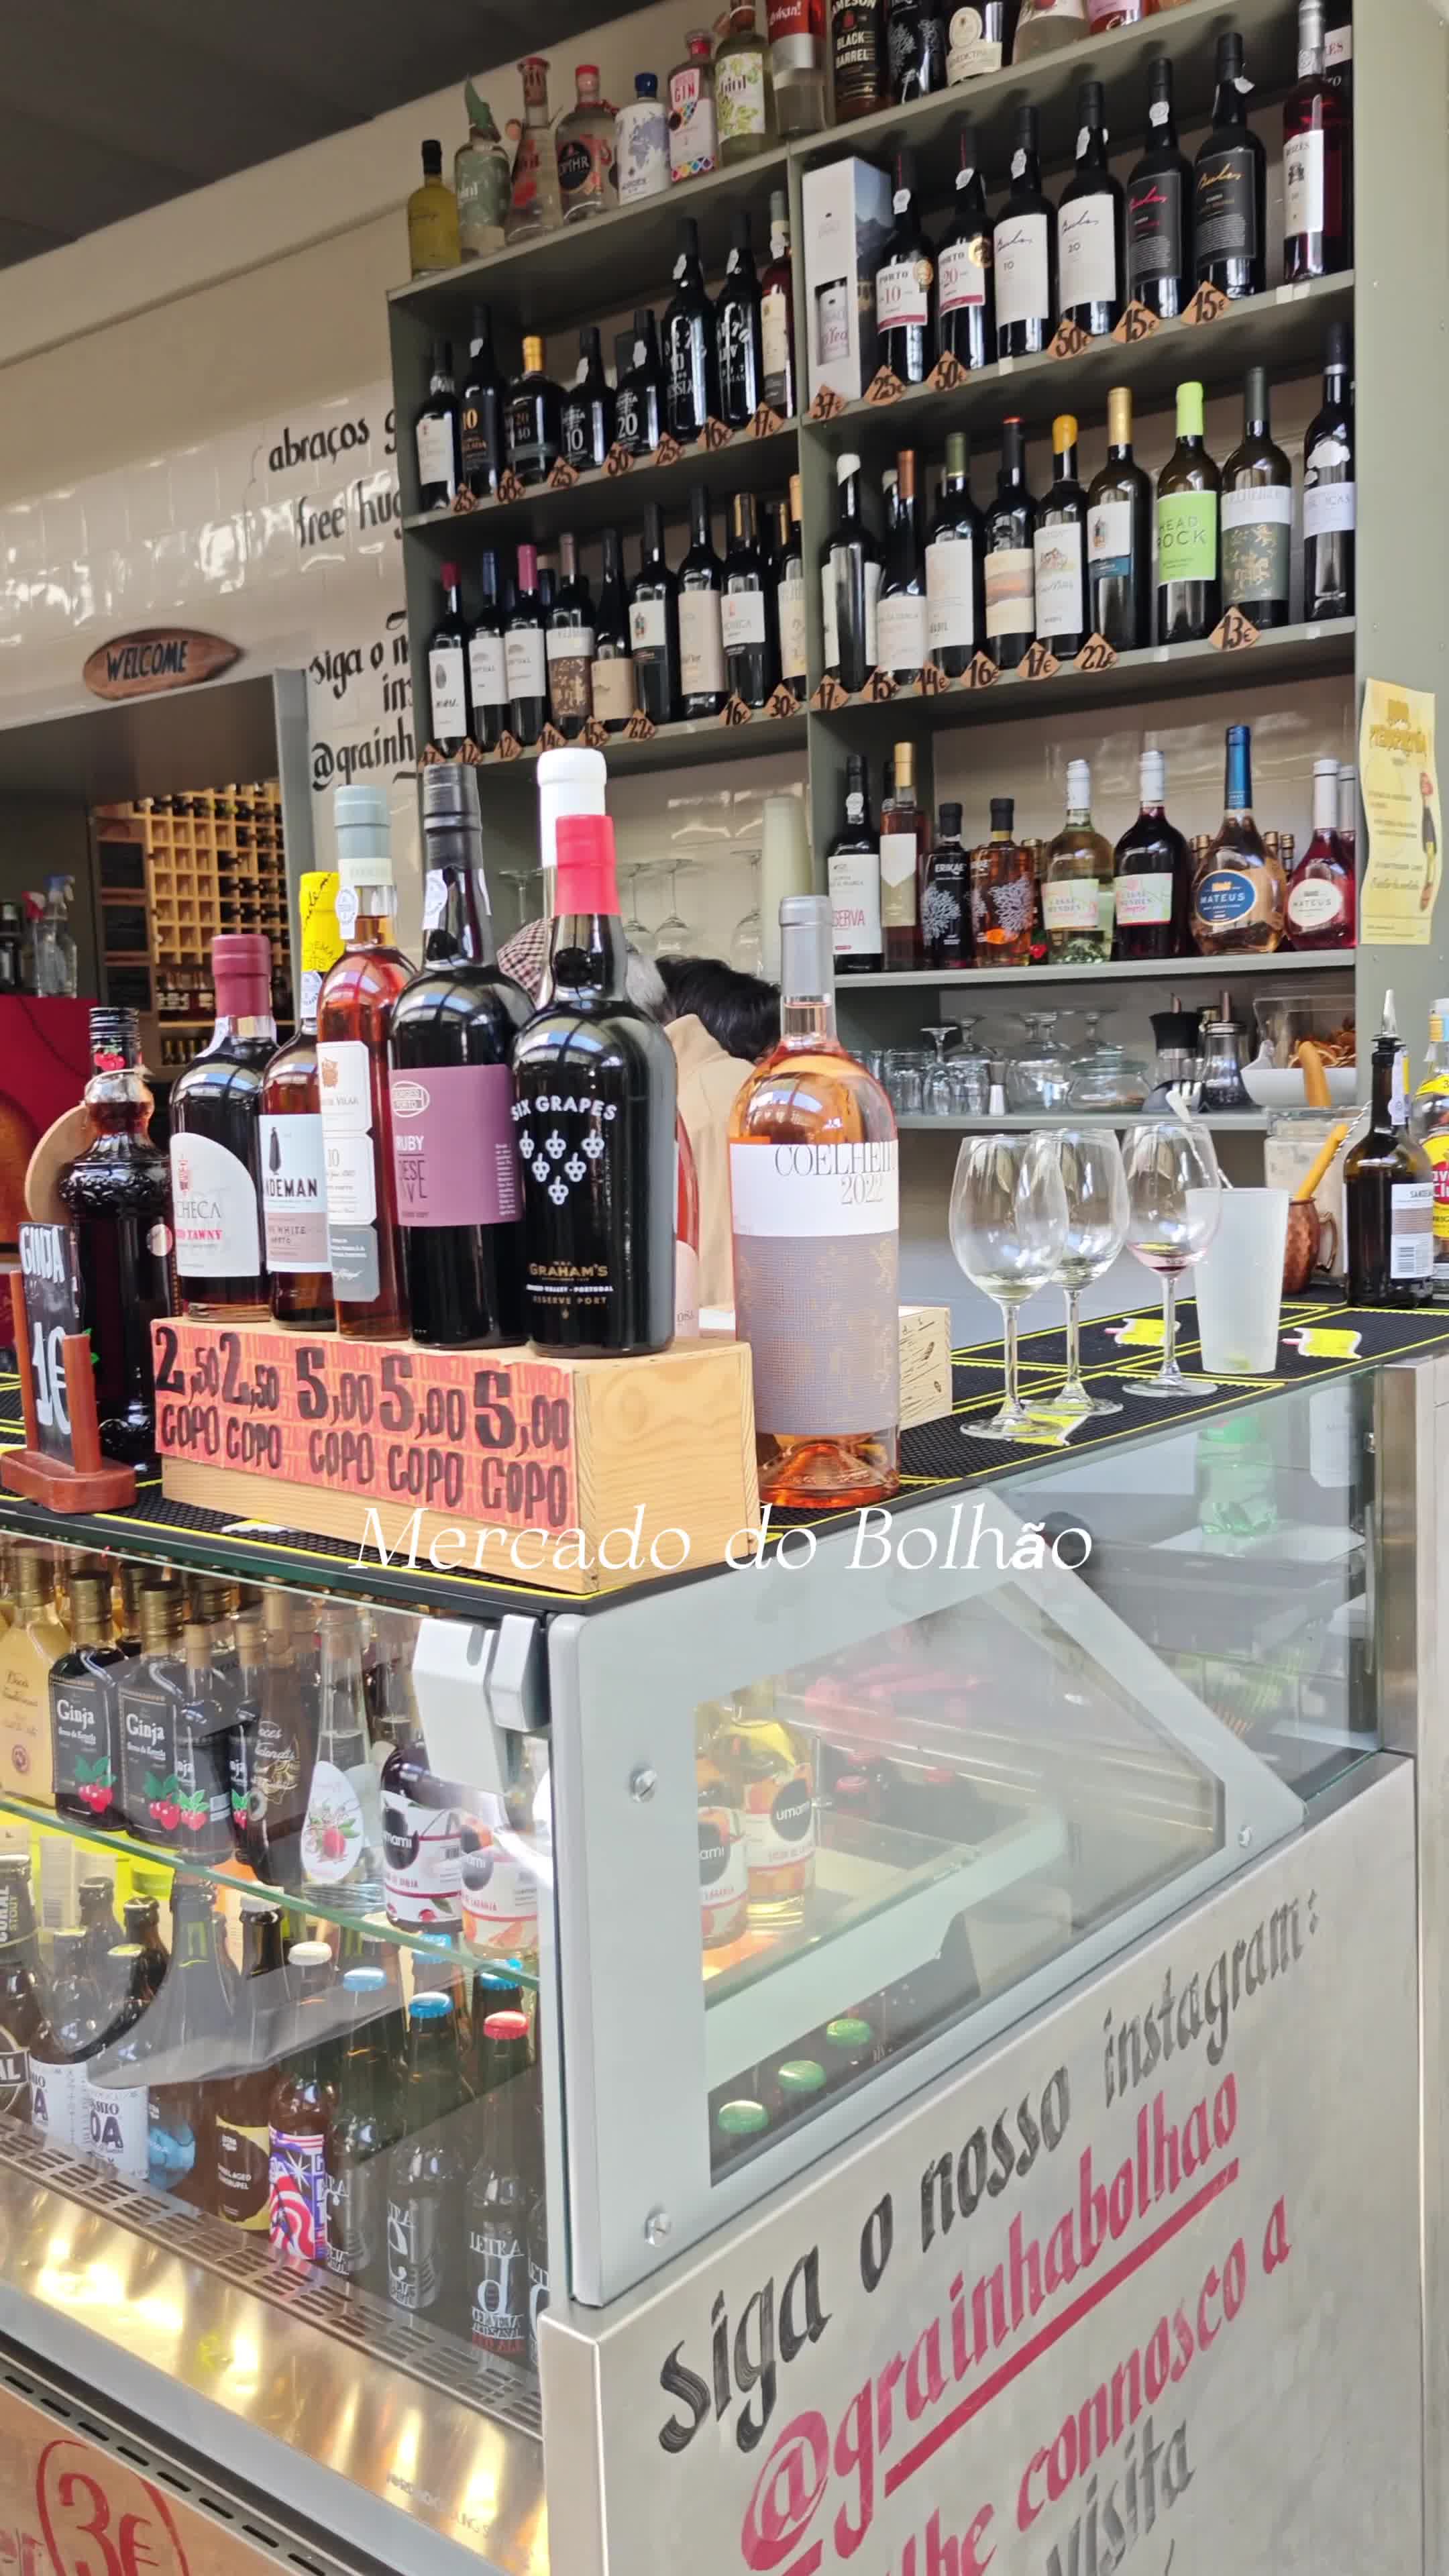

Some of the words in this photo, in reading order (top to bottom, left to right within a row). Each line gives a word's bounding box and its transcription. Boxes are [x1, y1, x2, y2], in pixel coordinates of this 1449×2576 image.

[837, 31, 865, 50] BLACK
[836, 48, 869, 69] BARREL
[675, 83, 695, 103] GIN
[885, 286, 902, 304] 10
[1190, 288, 1225, 324] 15€
[1121, 308, 1157, 343] 15€
[566, 428, 584, 452] 10
[617, 413, 638, 439] 20
[269, 417, 370, 473] abraços
[295, 496, 345, 548] free
[1219, 614, 1252, 649] 13€
[107, 640, 189, 682] WELCOME
[309, 648, 364, 700] siga
[370, 641, 384, 669] o
[969, 659, 999, 687] 16€
[1026, 648, 1053, 678] 17€
[1081, 644, 1114, 670] 22€
[817, 683, 841, 710] 17€
[916, 667, 946, 696] 14€
[724, 700, 748, 725] 16€
[770, 694, 796, 718] 30€
[629, 717, 652, 739] 22€
[1199, 892, 1246, 904] MATEUS
[511, 1099, 532, 1122] SIX
[535, 1095, 617, 1121] GRAPES
[187, 1229, 223, 1240] TAWNY
[530, 1263, 609, 1277] GRAHAM'S
[577, 1295, 607, 1305] PORT
[154, 1326, 221, 1405] 2,50
[220, 1331, 280, 1413] 2,50
[296, 1346, 373, 1426] 5,00
[378, 1353, 466, 1442] 5,00
[161, 1401, 221, 1456] COPO
[474, 1368, 571, 1457] 5,00
[225, 1416, 282, 1470] COPO
[309, 1429, 374, 1485] COPO
[388, 1444, 465, 1507] COPO
[480, 1456, 568, 1527] COPO
[57, 1699, 95, 1730] Ginja
[126, 1713, 165, 1746] Ginja
[659, 2245, 833, 2455] siga
[859, 2192, 894, 2293] o
[919, 2063, 1073, 2255] nosso
[1101, 1888, 1321, 2109] instagram:
[470, 2231, 525, 2257] LETRA
[477, 2255, 512, 2318] d
[740, 2072, 1240, 2573] @grainhabolhao
[887, 2504, 998, 2576] lhe
[1016, 2237, 1248, 2532] connosco
[1262, 2194, 1293, 2276] a
